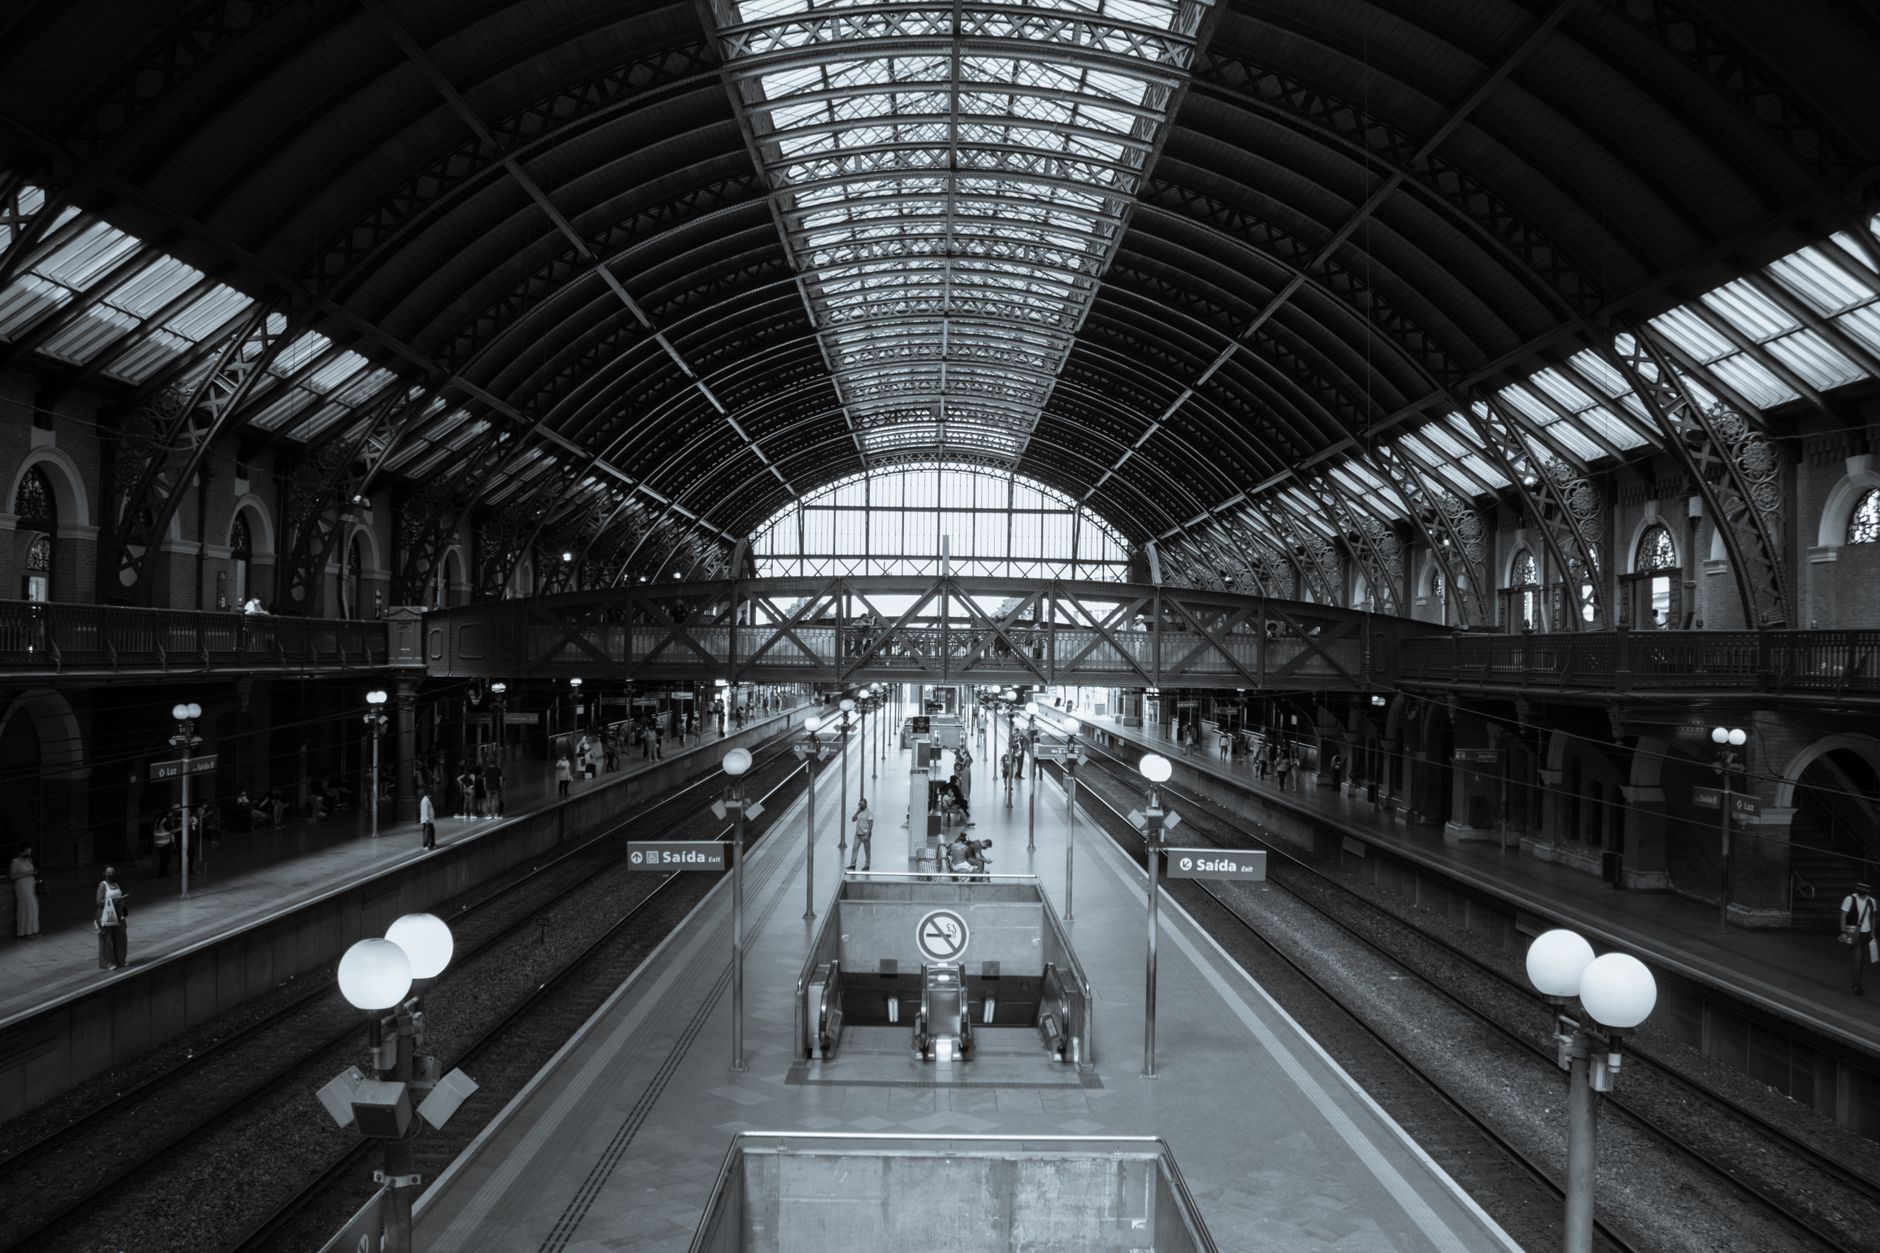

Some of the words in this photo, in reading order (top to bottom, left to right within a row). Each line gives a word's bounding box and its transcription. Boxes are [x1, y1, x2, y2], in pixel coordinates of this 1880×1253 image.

[1743, 801, 1755, 812] Luz
[662, 851, 705, 863] Saída
[1196, 859, 1237, 872] Saída
